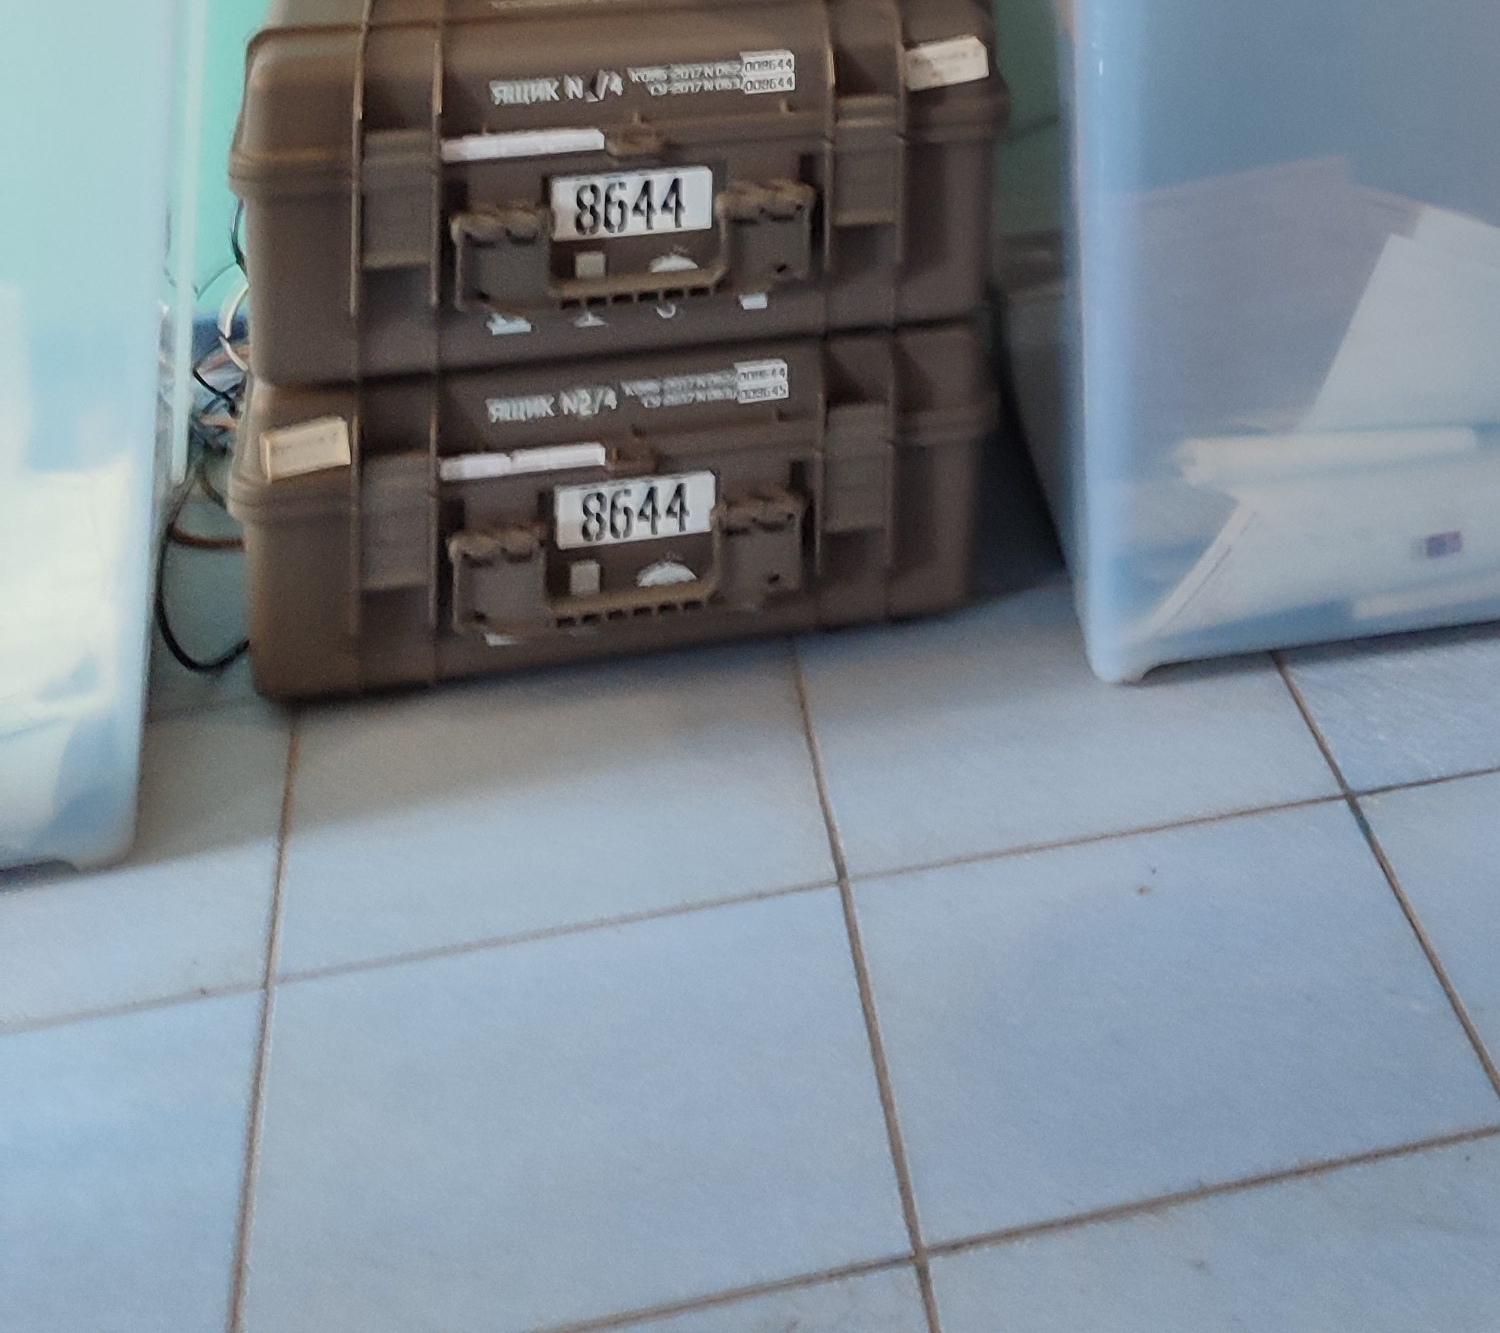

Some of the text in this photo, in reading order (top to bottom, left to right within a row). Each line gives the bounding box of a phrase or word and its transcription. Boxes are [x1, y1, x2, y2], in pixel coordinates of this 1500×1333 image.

[489, 77, 560, 105] ЯЩИК
[574, 176, 686, 235] 8644
[581, 481, 691, 543] 8644
